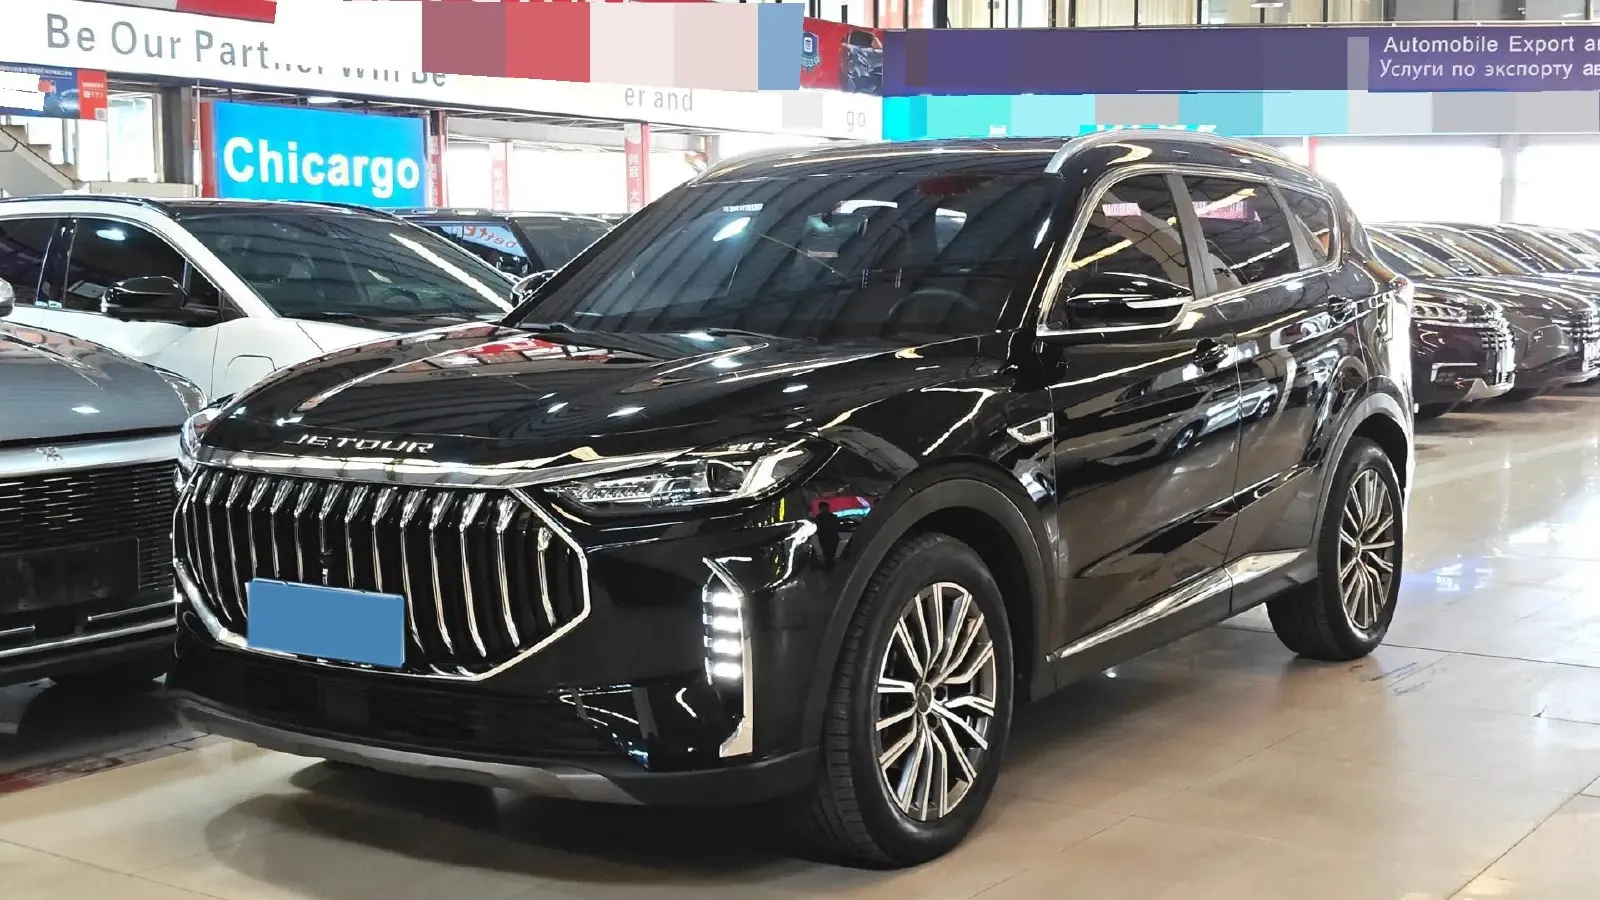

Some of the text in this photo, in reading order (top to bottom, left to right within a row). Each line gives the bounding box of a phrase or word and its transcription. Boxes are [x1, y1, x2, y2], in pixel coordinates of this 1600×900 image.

[46, 13, 96, 51] Be
[111, 20, 181, 60] Our
[1383, 35, 1600, 55] Automobile Export a
[1379, 59, 1444, 80] Услуги
[1452, 64, 1475, 77] по
[1484, 63, 1573, 80] экспорту
[653, 88, 693, 112] and
[223, 136, 420, 199] Chicargo
[283, 434, 434, 453] JETOUR
